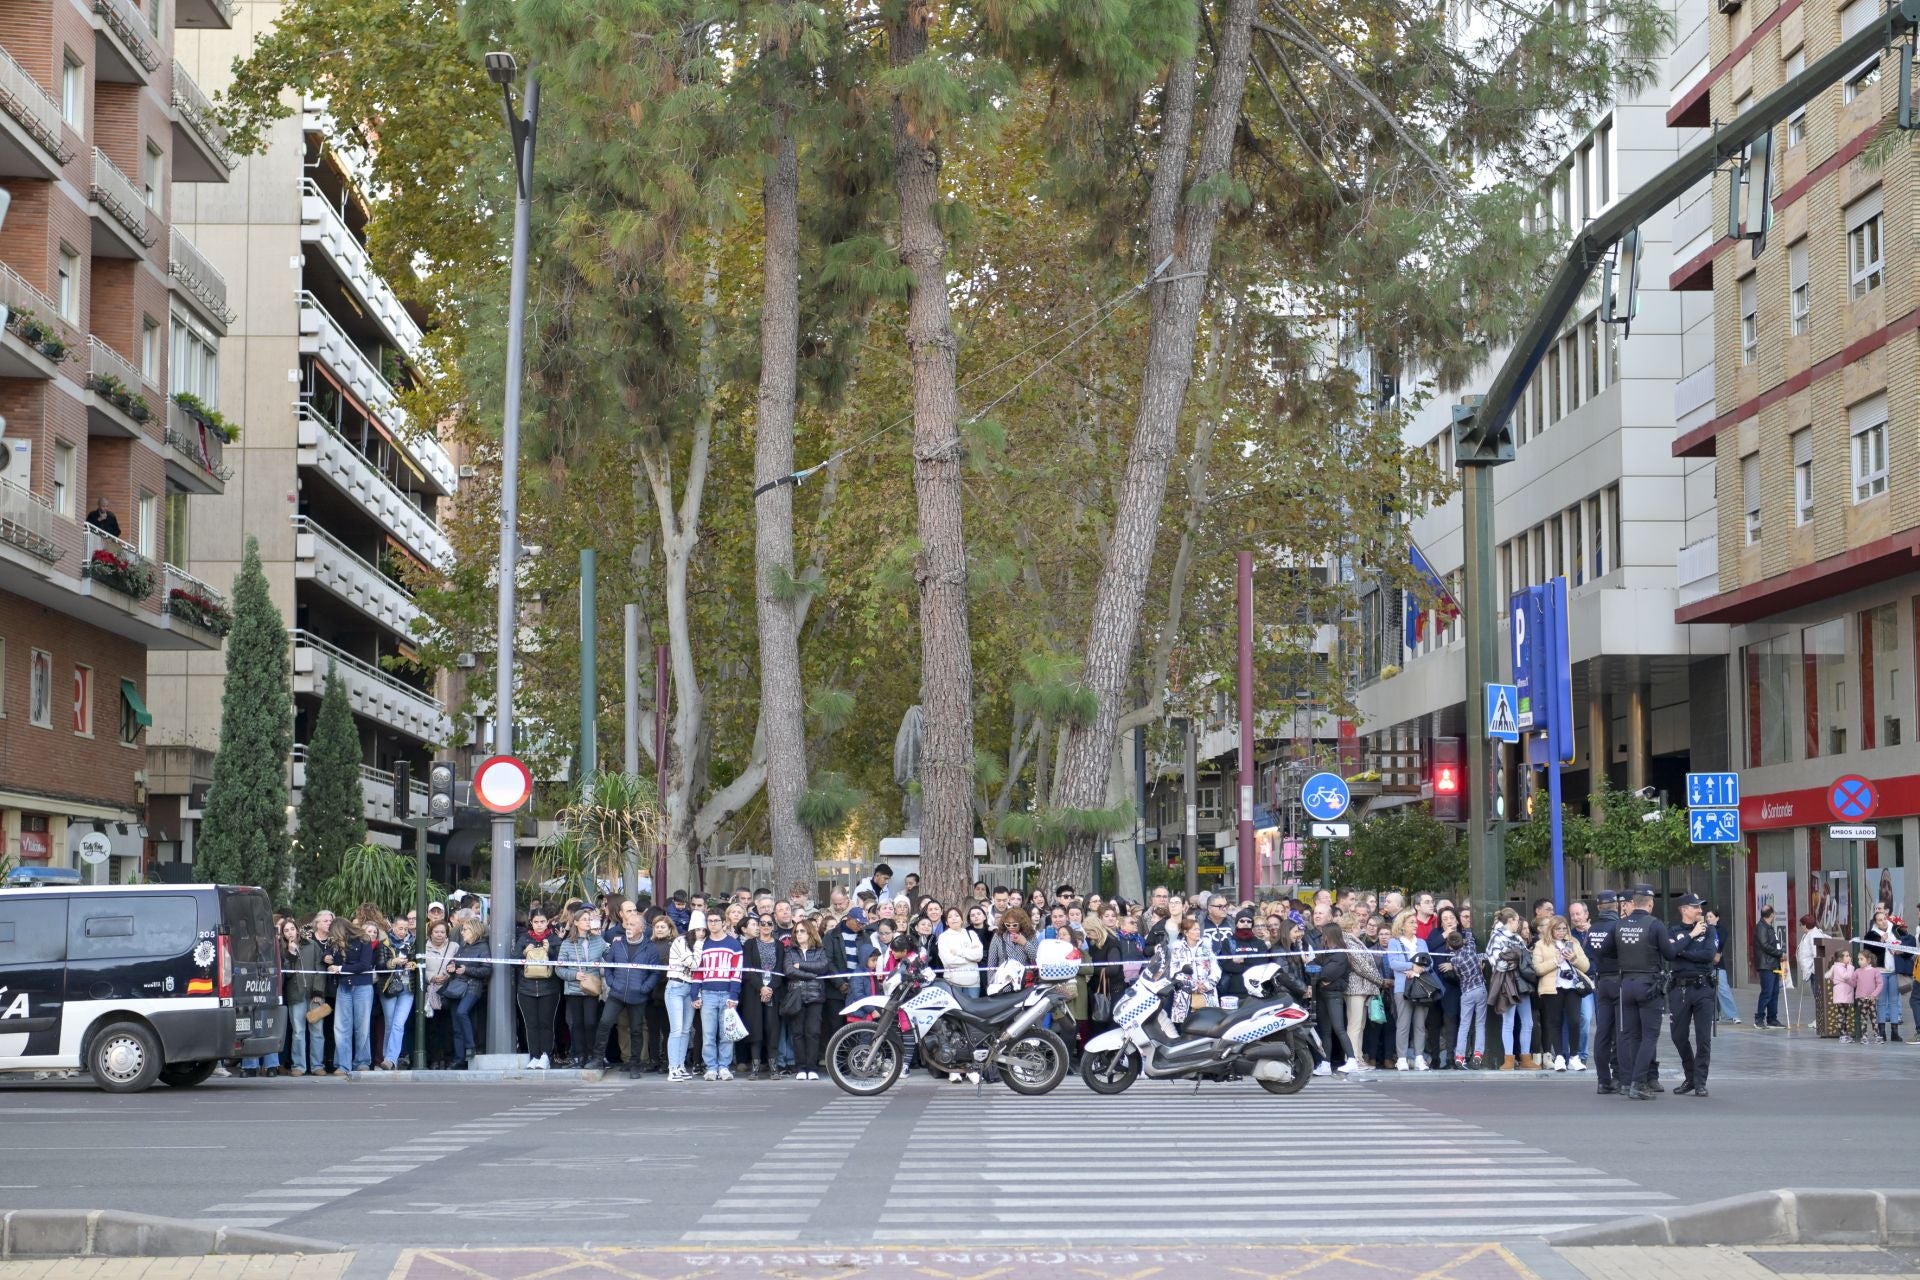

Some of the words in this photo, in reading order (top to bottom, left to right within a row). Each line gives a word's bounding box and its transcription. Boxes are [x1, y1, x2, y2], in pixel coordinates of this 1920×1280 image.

[1515, 607, 1525, 668] P
[1768, 802, 1793, 818] Santander
[245, 978, 270, 992] POLICÍA
[1267, 1019, 1287, 1032] 092
